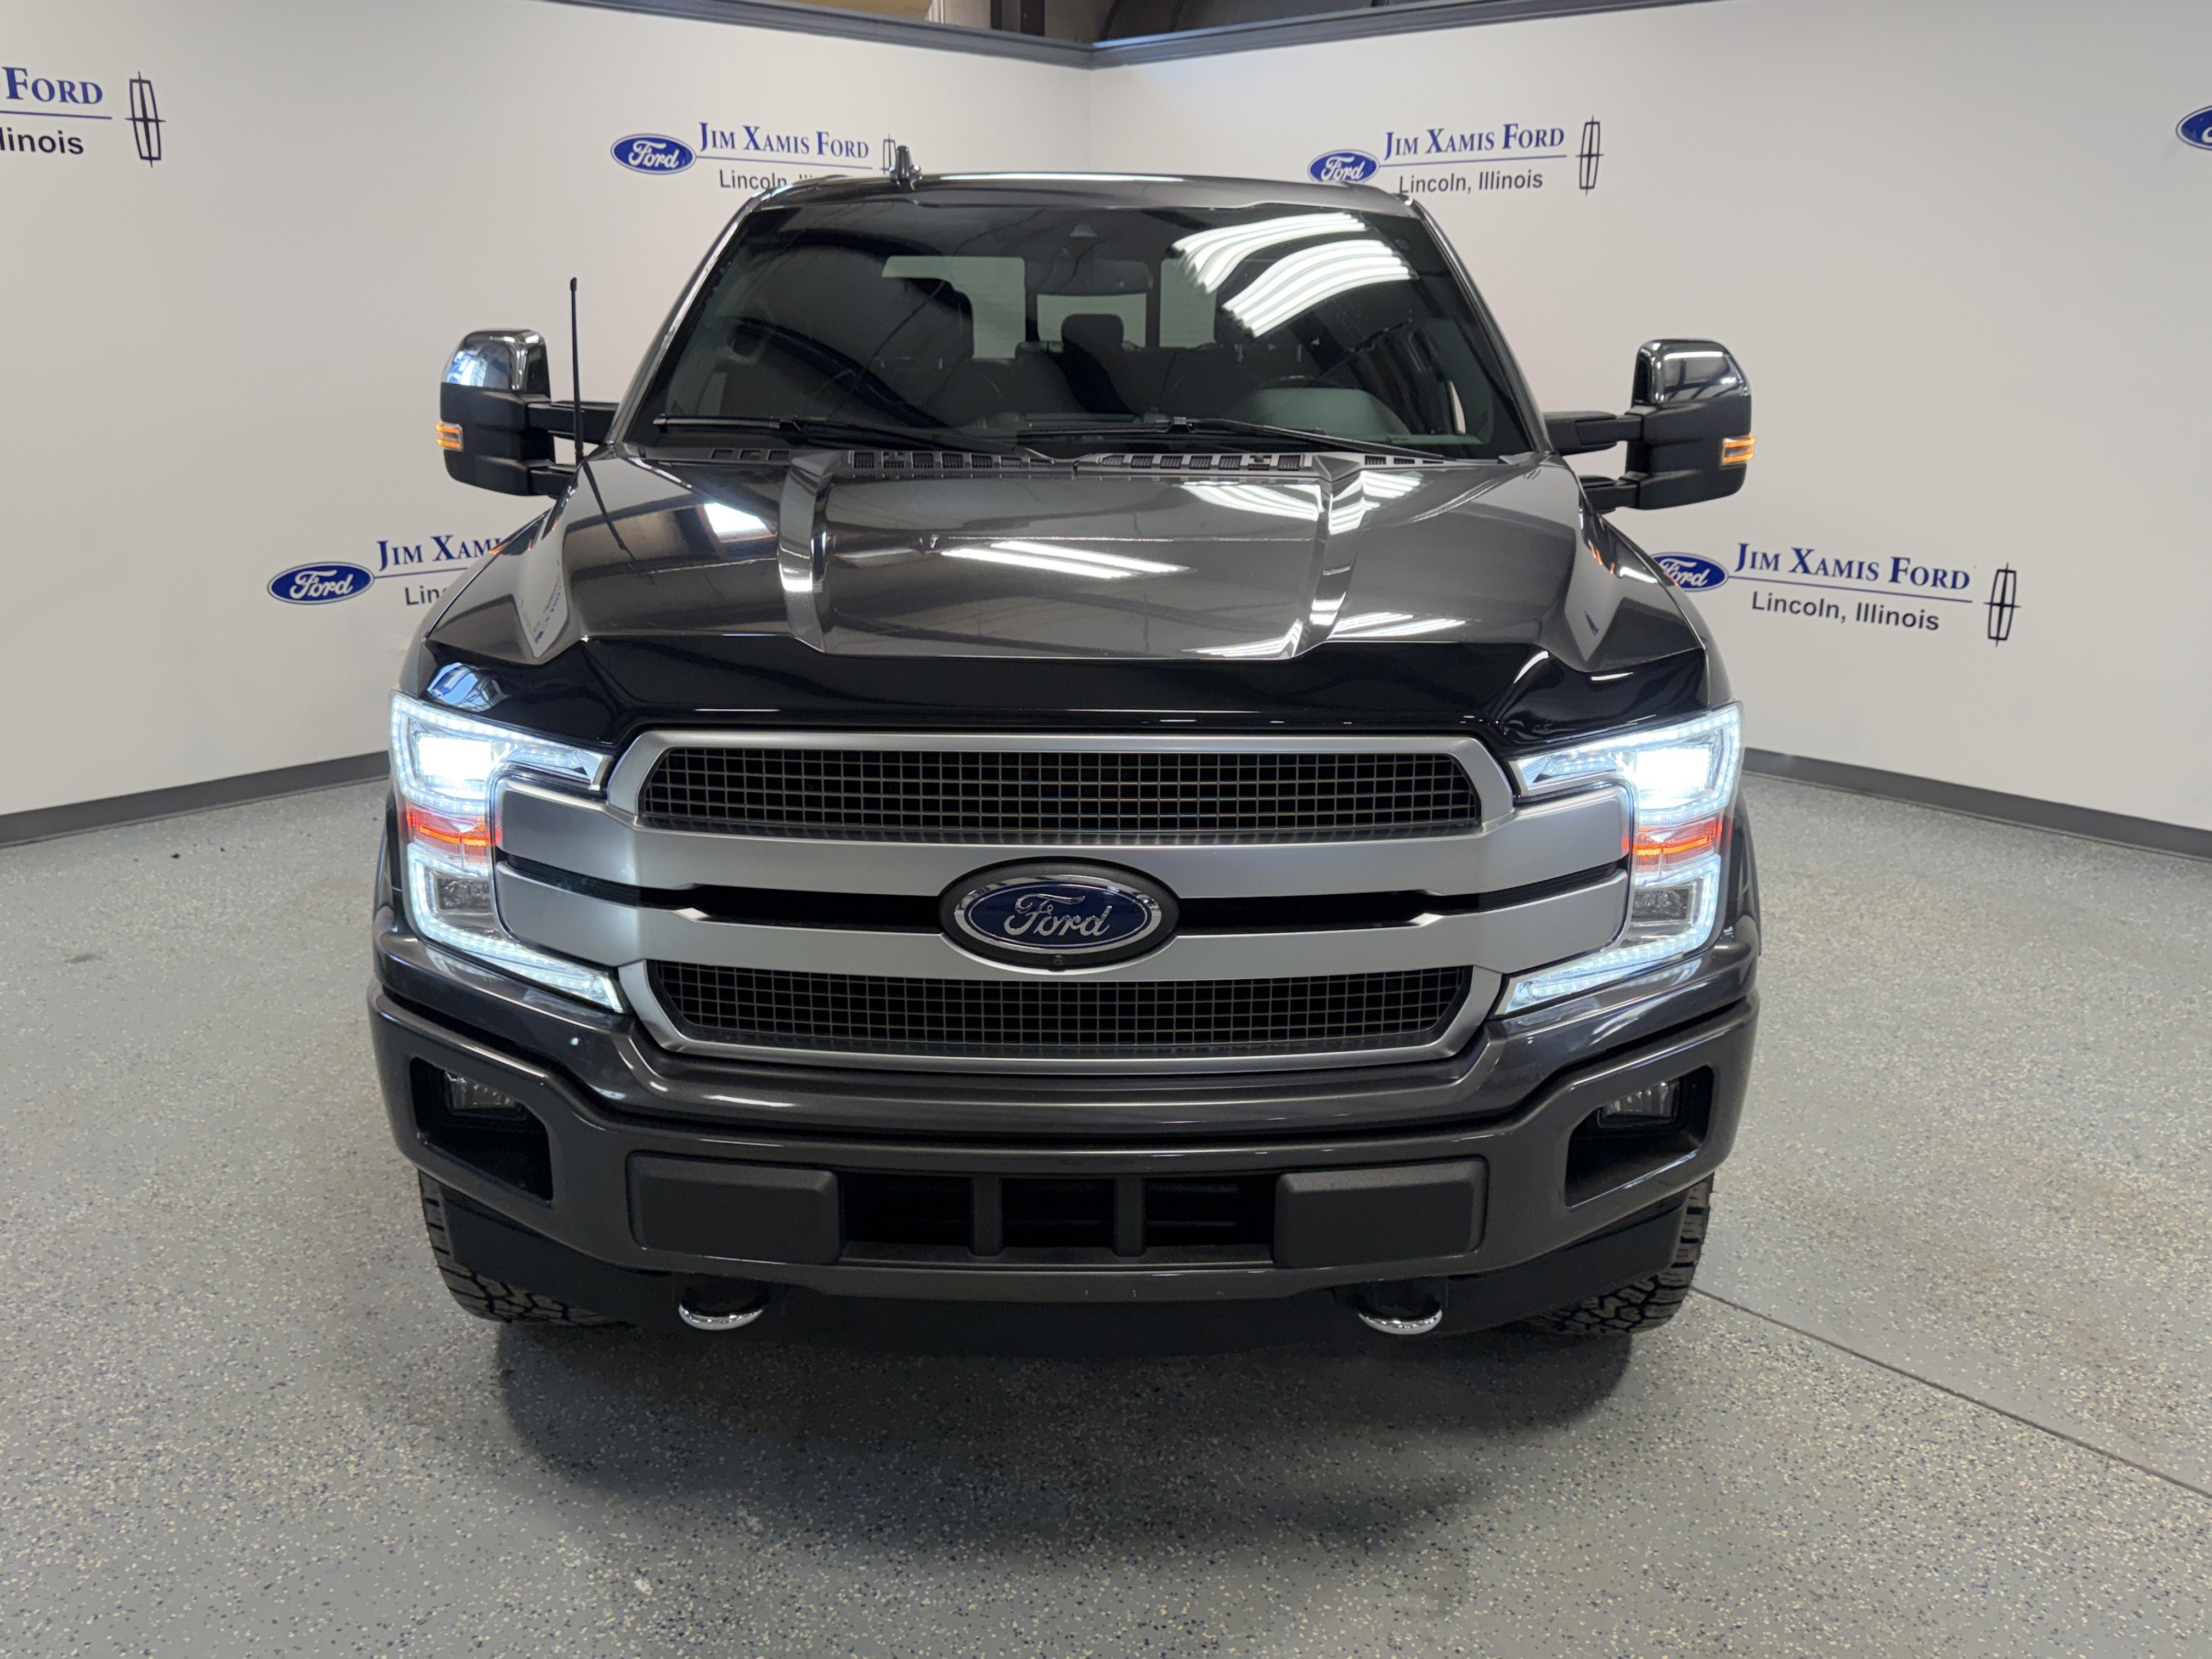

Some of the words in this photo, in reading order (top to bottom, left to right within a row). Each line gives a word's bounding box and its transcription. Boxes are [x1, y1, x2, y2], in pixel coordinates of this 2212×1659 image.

[2, 66, 103, 104] FORD
[628, 140, 680, 168] Ford
[699, 122, 736, 152] JIM
[742, 125, 810, 154] XAMIS
[816, 131, 869, 158] FORD
[1384, 132, 1419, 161] JIM
[1424, 128, 1494, 154] XAMIS
[1502, 123, 1565, 149] FORD
[1321, 156, 1365, 180] Ford
[1399, 173, 1471, 195] Lincoln,
[1479, 170, 1543, 190] Illinois
[376, 540, 424, 572] JIM
[1734, 543, 1781, 572] JIM
[1788, 547, 1880, 582] XAMIS
[1888, 556, 1970, 590] FORD
[289, 569, 353, 599] Ford
[405, 585, 447, 606] Lin
[1752, 591, 1846, 623] Lincoln,
[1856, 602, 1939, 630] Illinois
[1004, 894, 1112, 936] Ford
